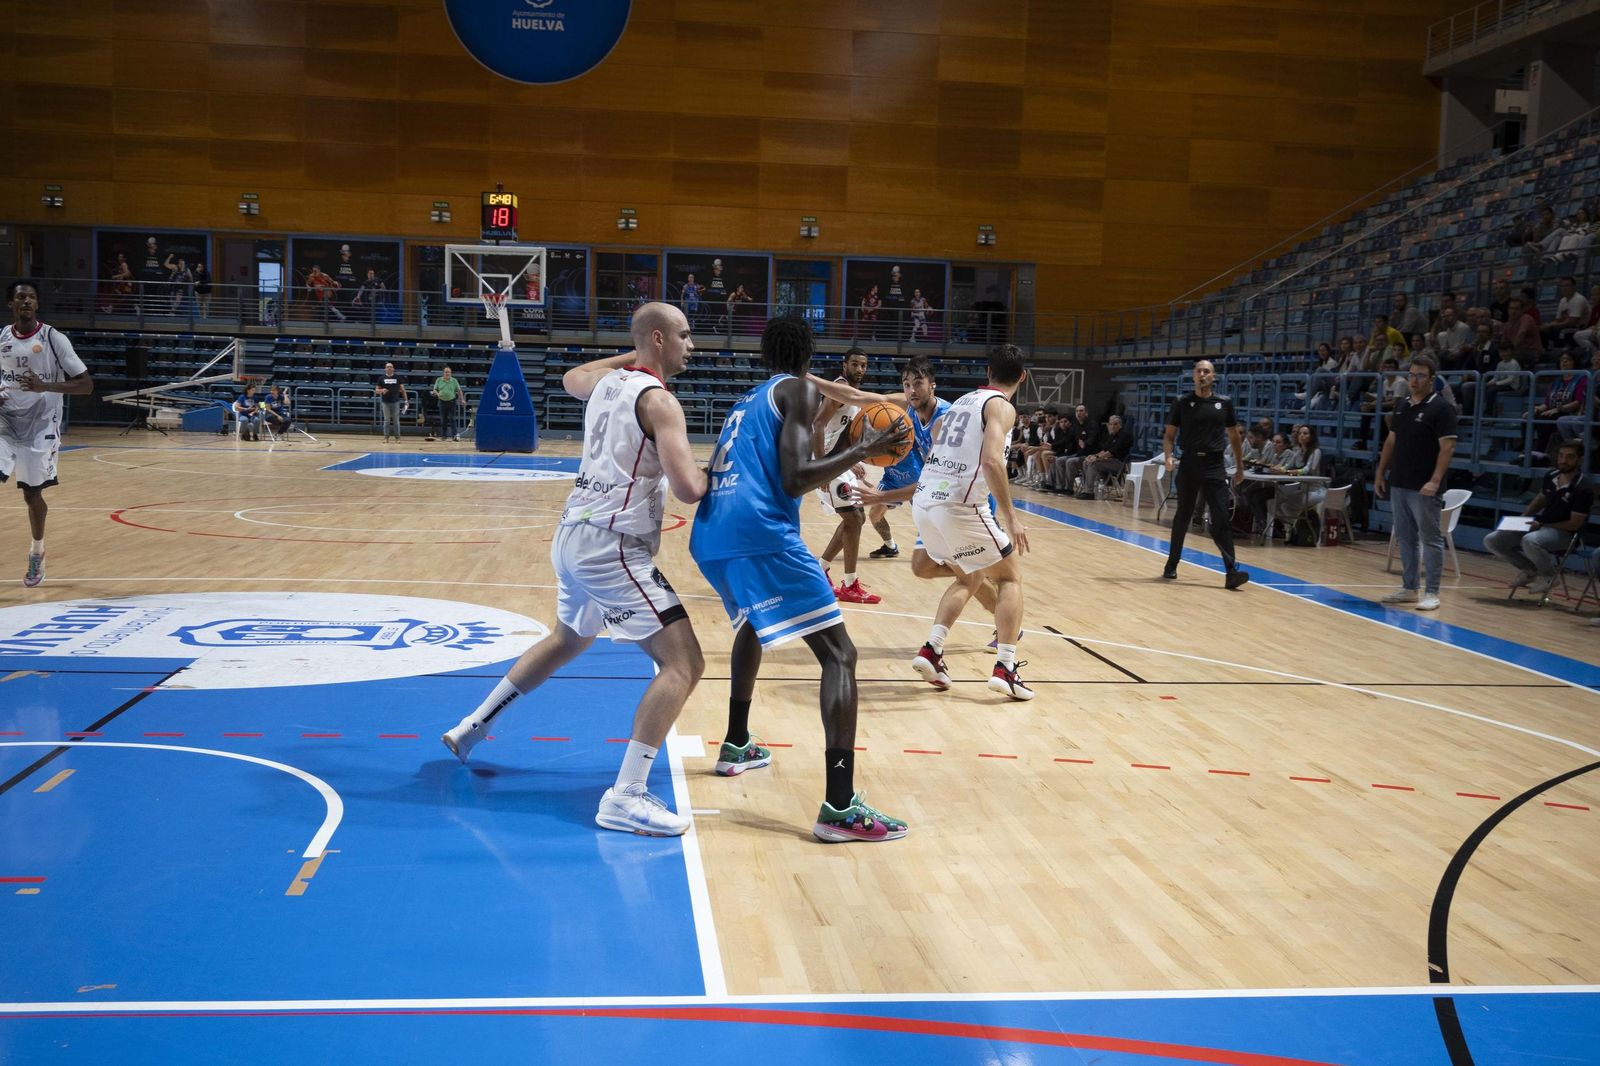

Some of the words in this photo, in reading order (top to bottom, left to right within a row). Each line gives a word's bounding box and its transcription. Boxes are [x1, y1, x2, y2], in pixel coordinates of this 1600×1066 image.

[511, 18, 565, 31] HUELVA
[489, 194, 512, 205] 6:48
[492, 207, 509, 227] 18
[16, 356, 28, 368] 12
[590, 411, 611, 460] 8
[936, 410, 971, 448] 33
[1328, 525, 1338, 541] 5
[751, 595, 784, 611] HYUNDAI
[0, 605, 137, 656] HUELVA
